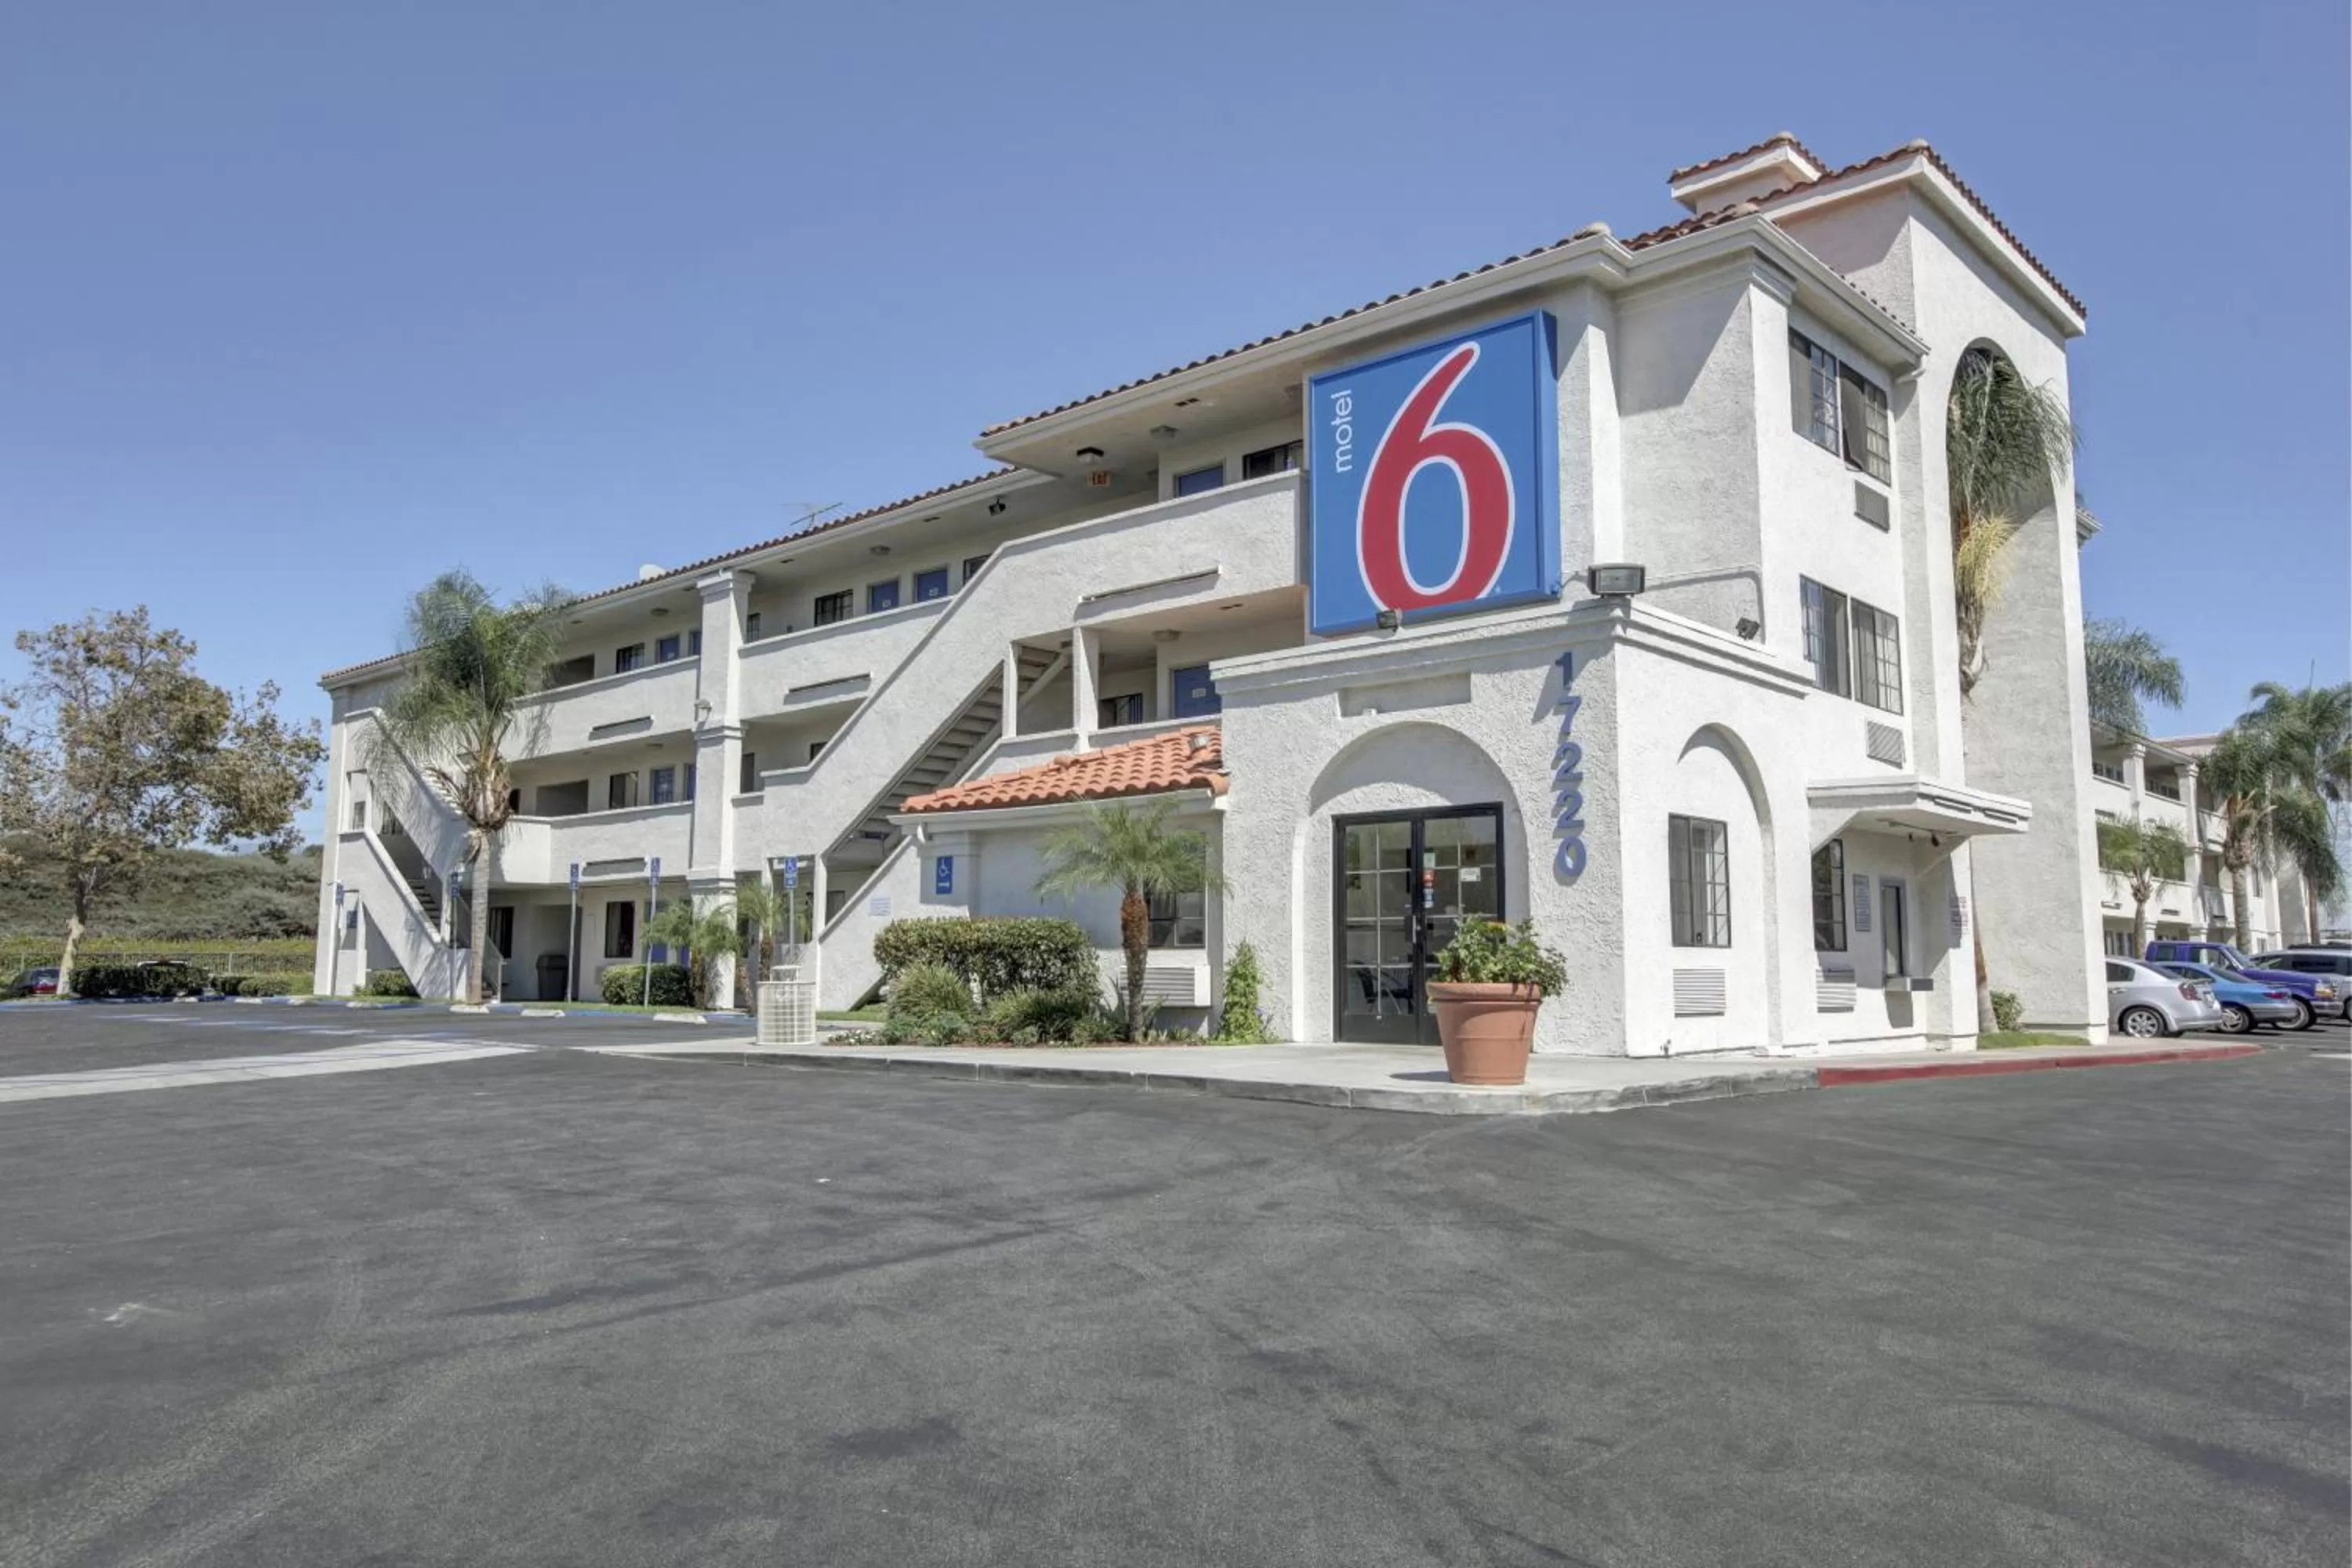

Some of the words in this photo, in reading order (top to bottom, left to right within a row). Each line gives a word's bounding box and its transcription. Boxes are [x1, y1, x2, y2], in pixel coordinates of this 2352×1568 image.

[1330, 390, 1352, 474] motel
[1356, 341, 1515, 612] 6
[1555, 652, 1587, 877] 17220
